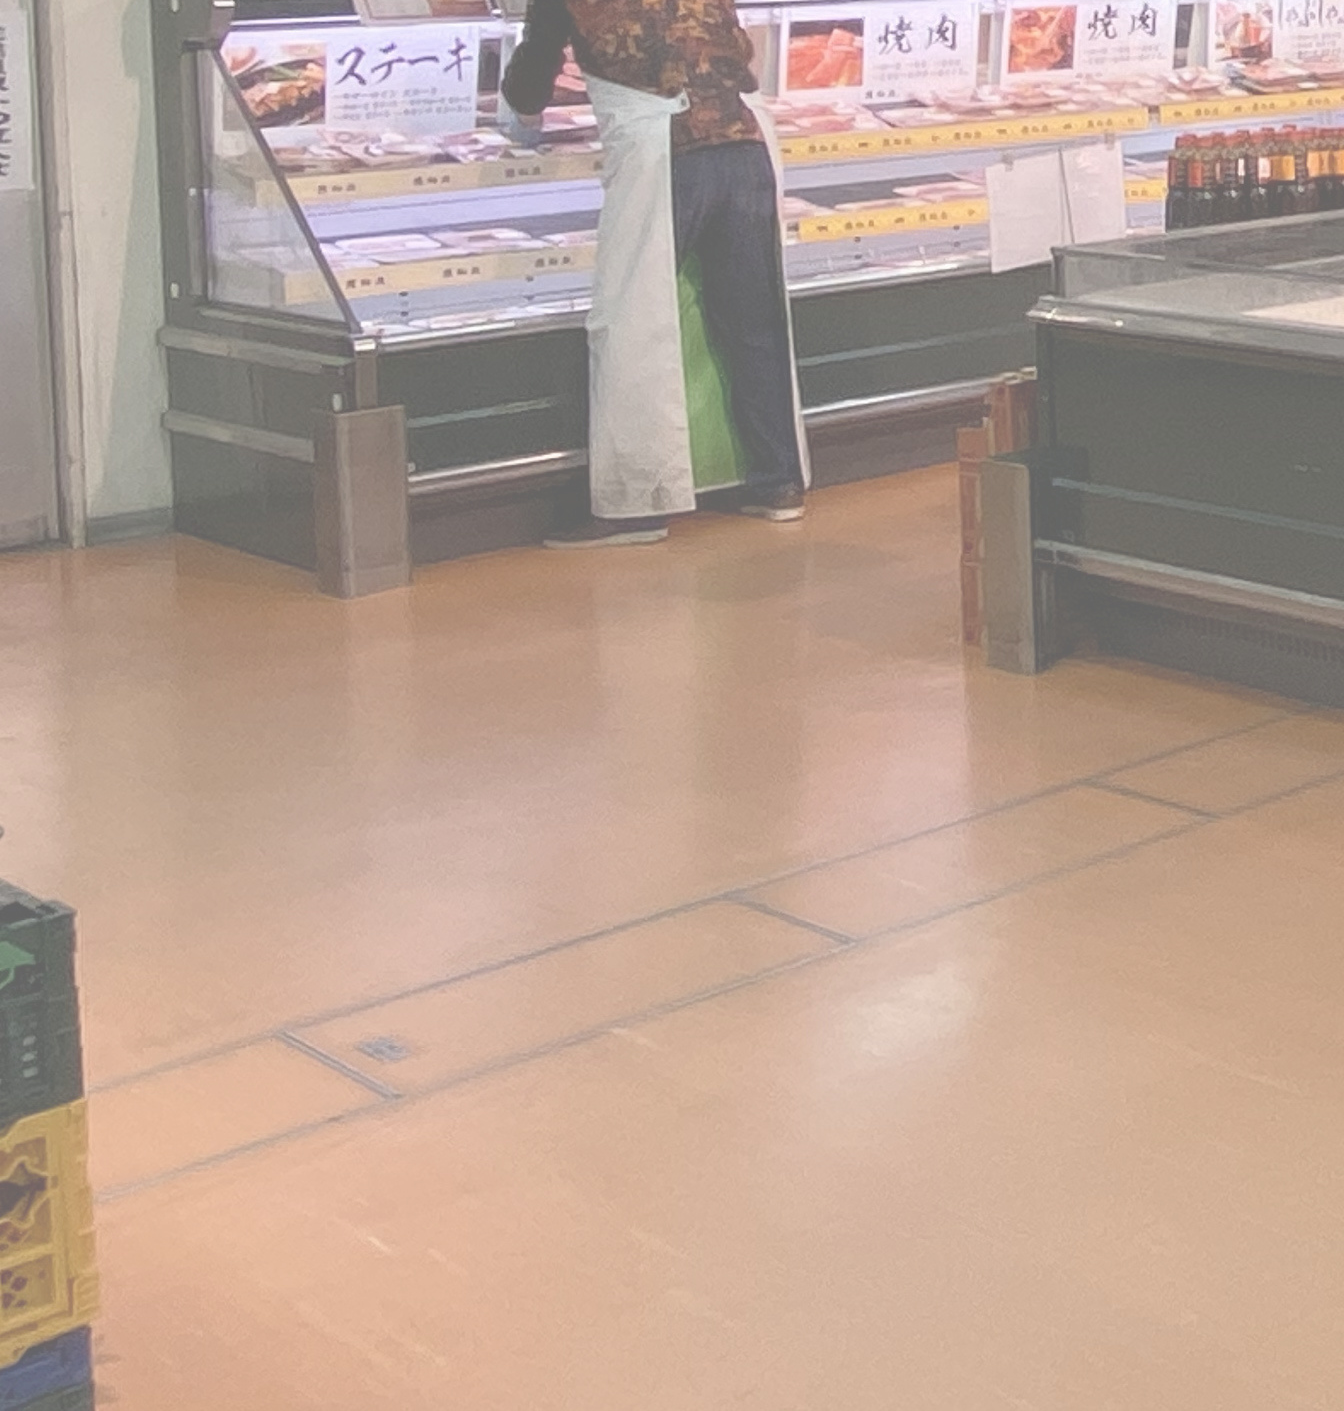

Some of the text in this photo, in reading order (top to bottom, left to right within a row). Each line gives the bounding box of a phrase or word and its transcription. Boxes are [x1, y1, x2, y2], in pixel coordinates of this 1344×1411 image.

[877, 13, 958, 56] 焼肉
[1087, 2, 1158, 42] 焼肉
[333, 36, 475, 86] ステーキ
